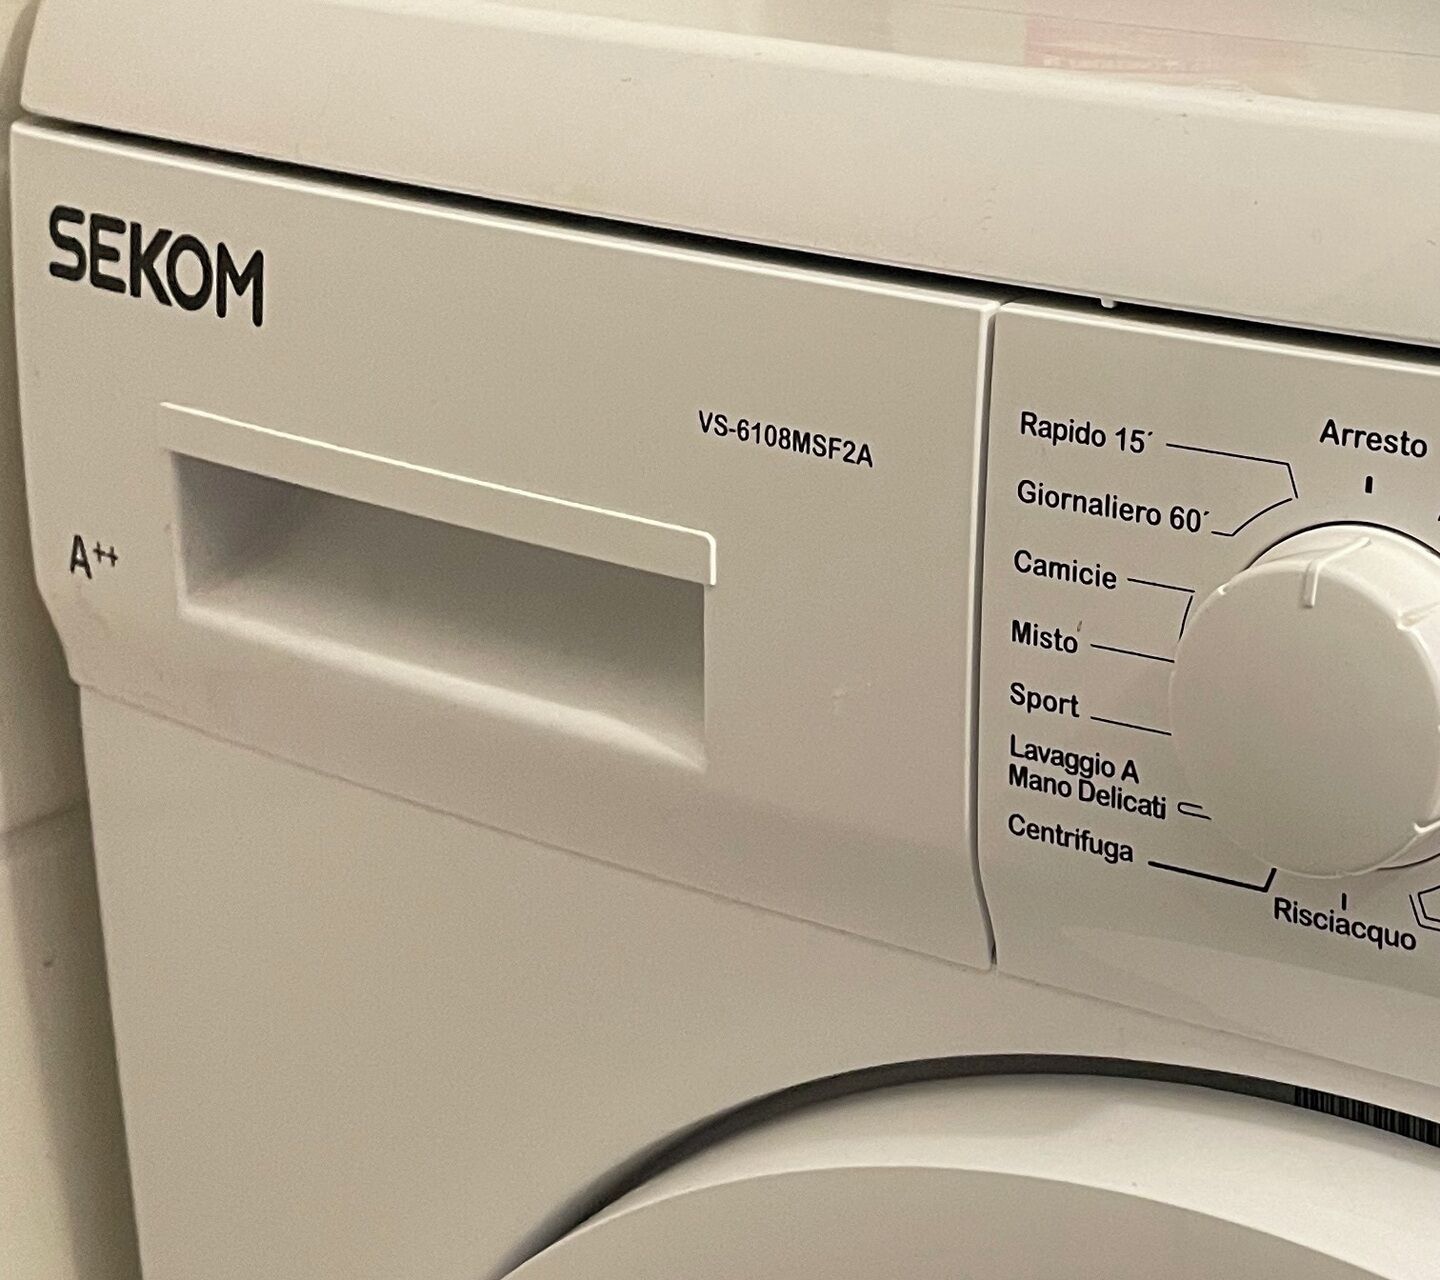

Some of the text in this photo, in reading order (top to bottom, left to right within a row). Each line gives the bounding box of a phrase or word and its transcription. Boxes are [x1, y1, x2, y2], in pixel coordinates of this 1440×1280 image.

[48, 205, 266, 328] SEKOM
[697, 408, 875, 470] VS-6108MSF2A
[1020, 410, 1107, 448] Rapido
[1319, 418, 1429, 459] Arresto
[1016, 478, 1162, 526] Giornaliero
[68, 533, 120, 580] A++
[1012, 548, 1118, 590] Camicie
[1010, 619, 1079, 654] Misto
[1009, 681, 1080, 719] Sport
[1009, 733, 1140, 785] Lavaggio A
[1008, 763, 1167, 821] Mano Delicati
[1007, 812, 1134, 865] Centrifuga
[1272, 895, 1417, 951] Risciacquo
